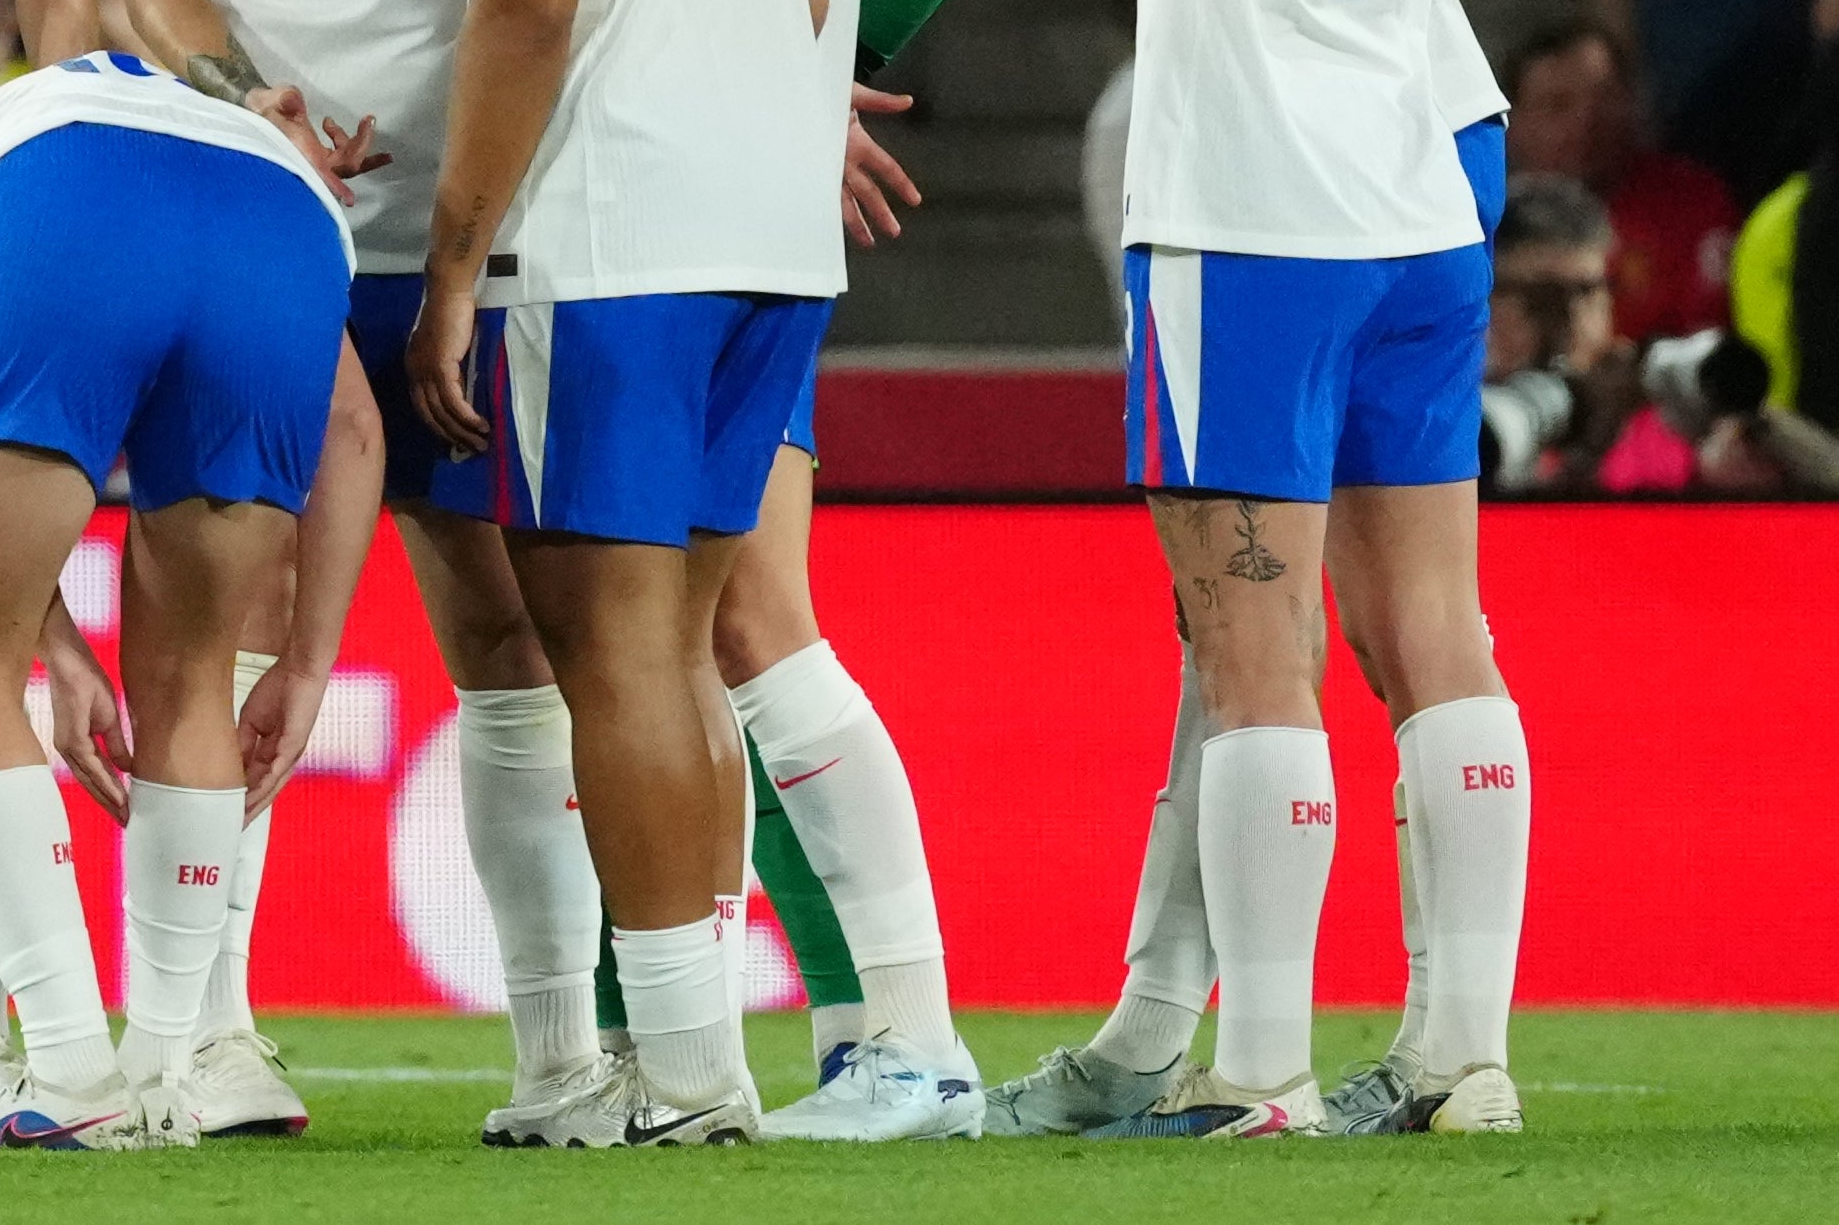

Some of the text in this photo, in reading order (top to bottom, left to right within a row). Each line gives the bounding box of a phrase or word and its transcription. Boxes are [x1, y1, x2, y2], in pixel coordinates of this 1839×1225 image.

[1462, 764, 1516, 791] ENG
[1292, 801, 1332, 826] ENG
[177, 864, 220, 886] ENG
[715, 900, 735, 920] NG
